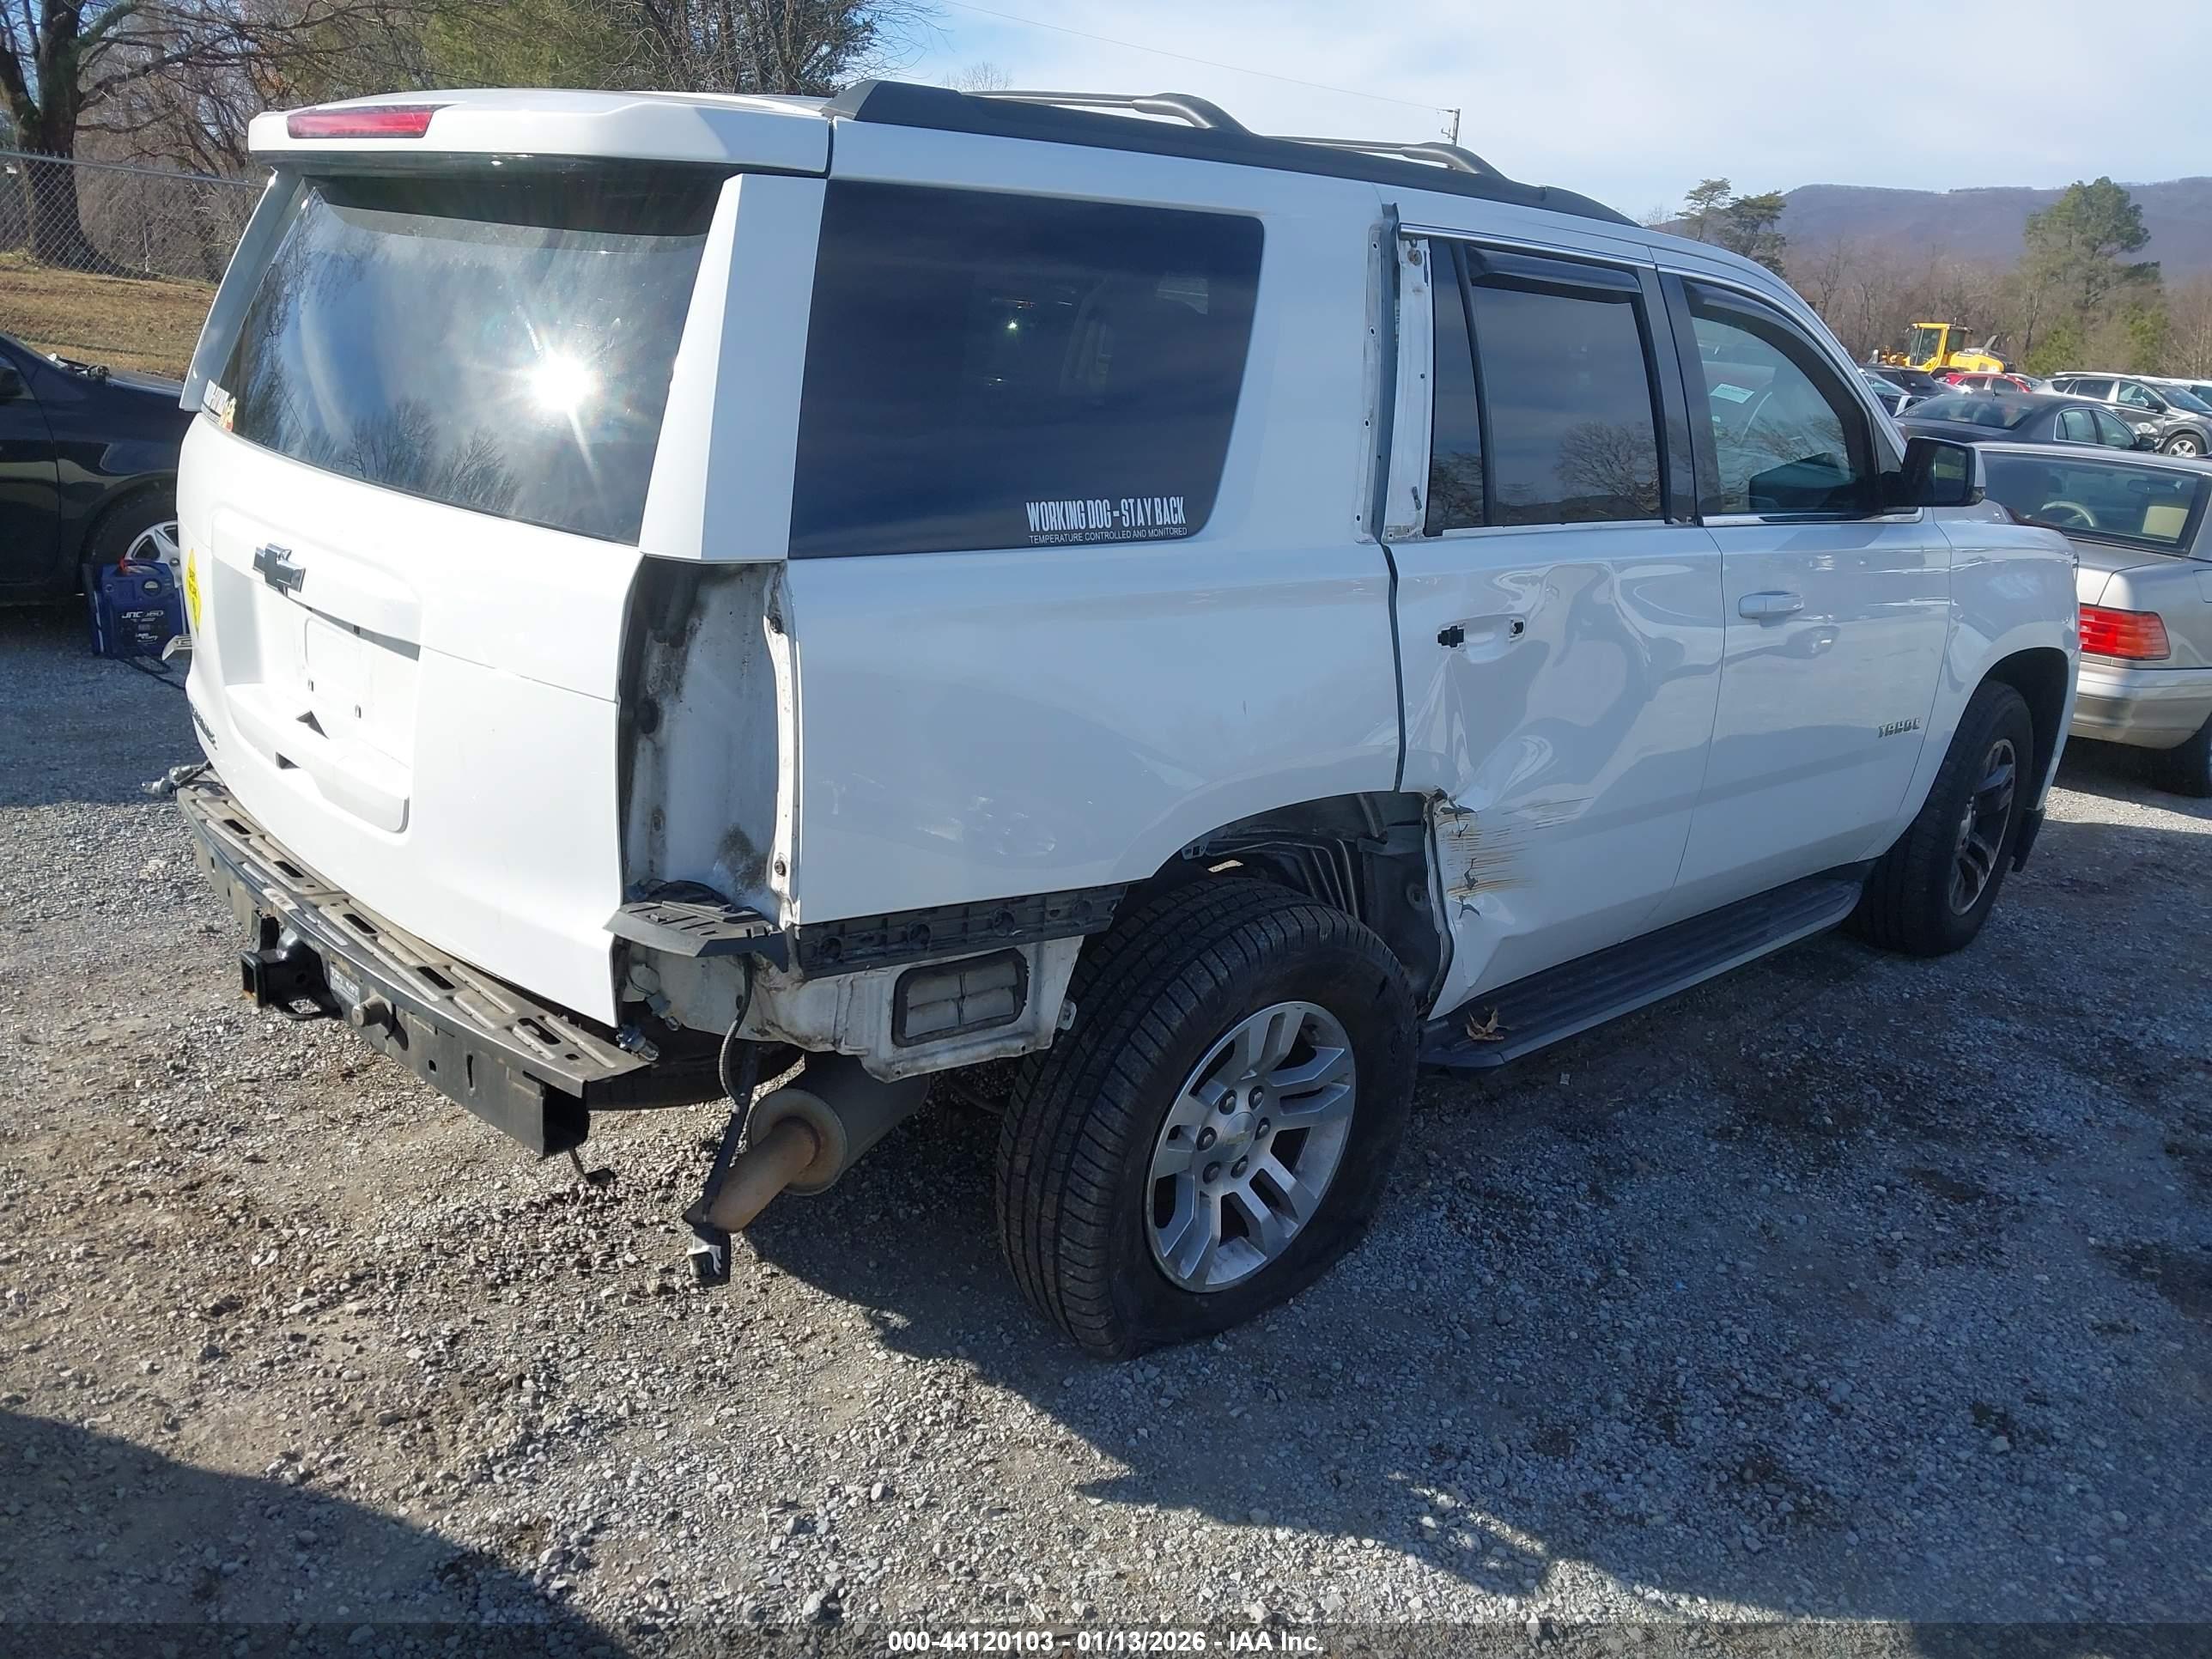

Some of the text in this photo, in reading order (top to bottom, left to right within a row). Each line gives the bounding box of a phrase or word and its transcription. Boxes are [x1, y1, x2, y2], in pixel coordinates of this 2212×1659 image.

[1026, 500, 1086, 532] WORKING
[1086, 499, 1112, 529] DOG
[1121, 497, 1152, 527] STAY
[1154, 496, 1187, 526] BACK
[1029, 527, 1188, 544] TEMPERATURE CONTROLLED AND MONITORED
